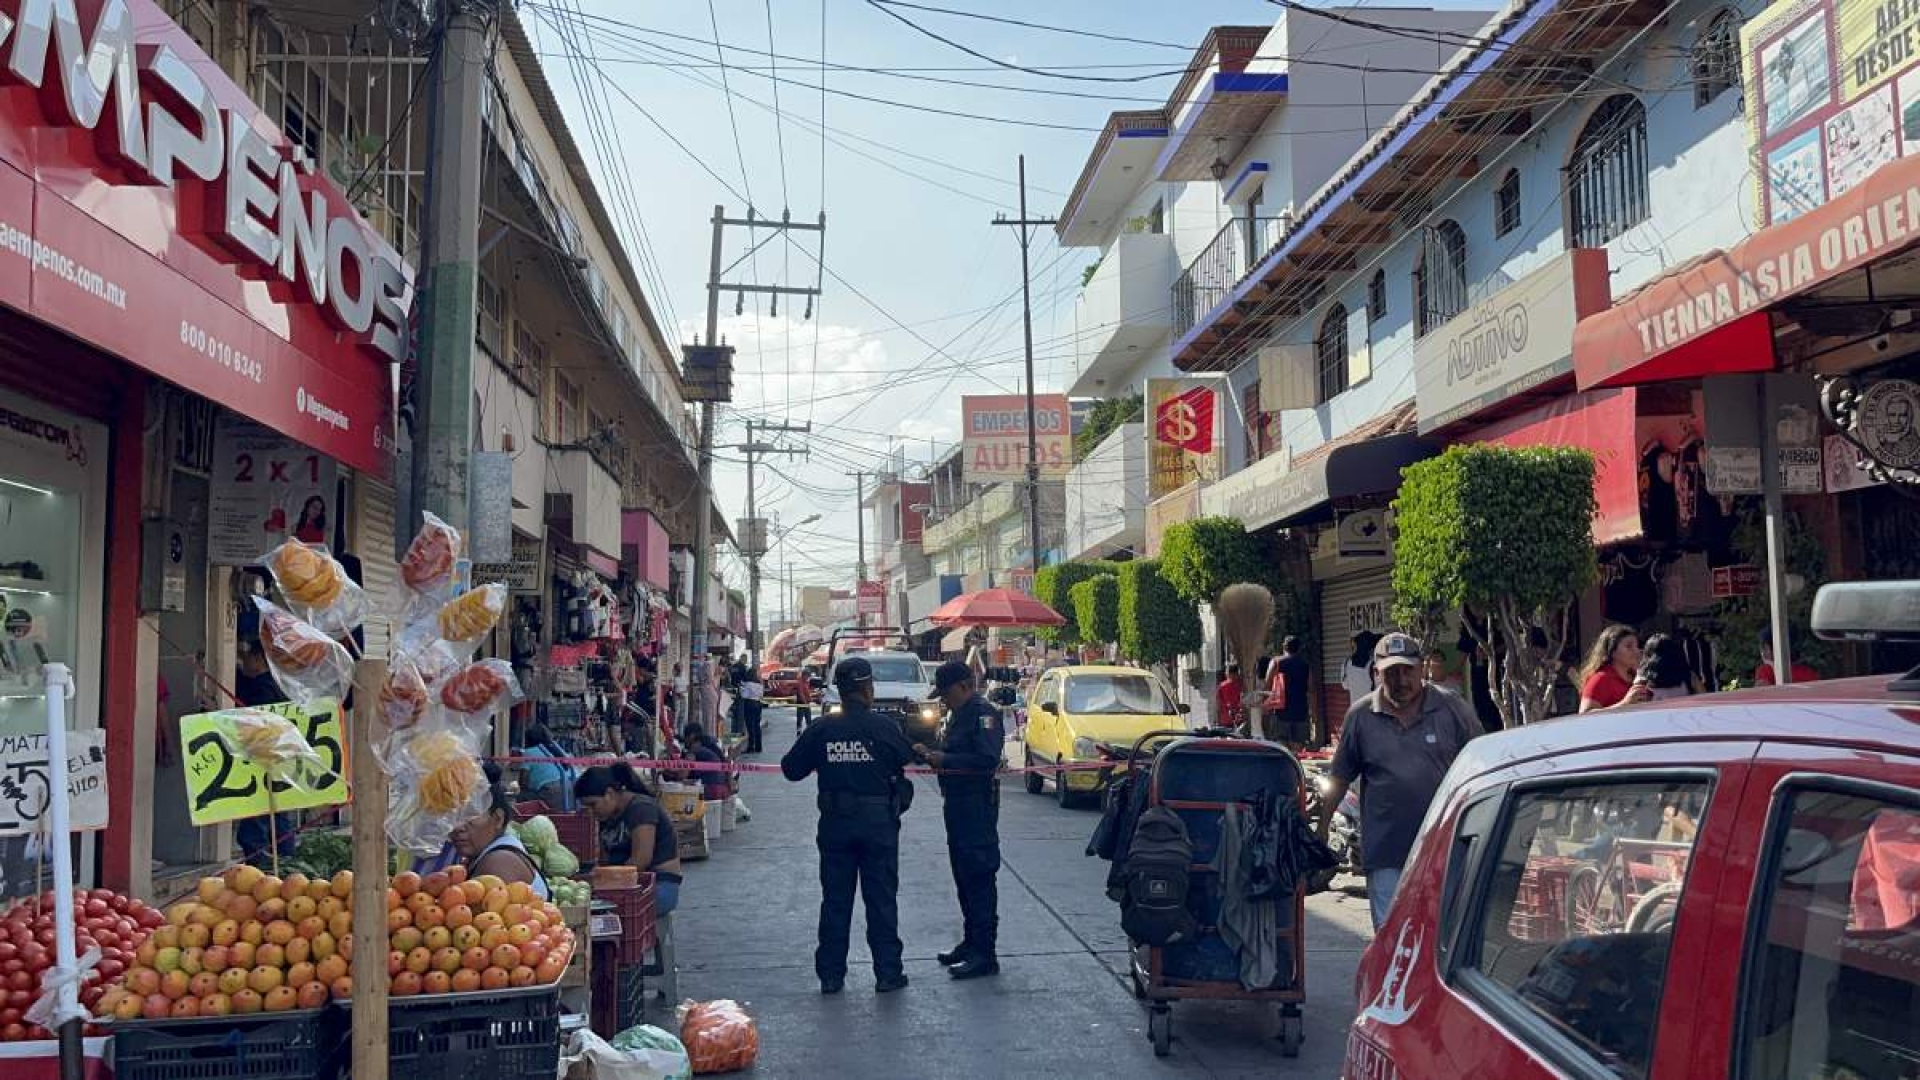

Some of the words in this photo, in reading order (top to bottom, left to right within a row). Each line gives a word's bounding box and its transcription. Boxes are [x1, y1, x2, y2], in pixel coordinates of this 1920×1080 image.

[1855, 27, 1914, 87] DESDE
[0, 0, 413, 363] MPEÑOS
[1638, 283, 1735, 353] TIENDA
[1739, 243, 1815, 312] ASIA
[180, 319, 206, 353] 800
[208, 336, 231, 368] 010
[234, 351, 263, 384] 6342
[972, 410, 1061, 433] EMPEOS
[235, 452, 255, 484] 2
[306, 455, 320, 484] 1
[1349, 602, 1384, 632] RENTA
